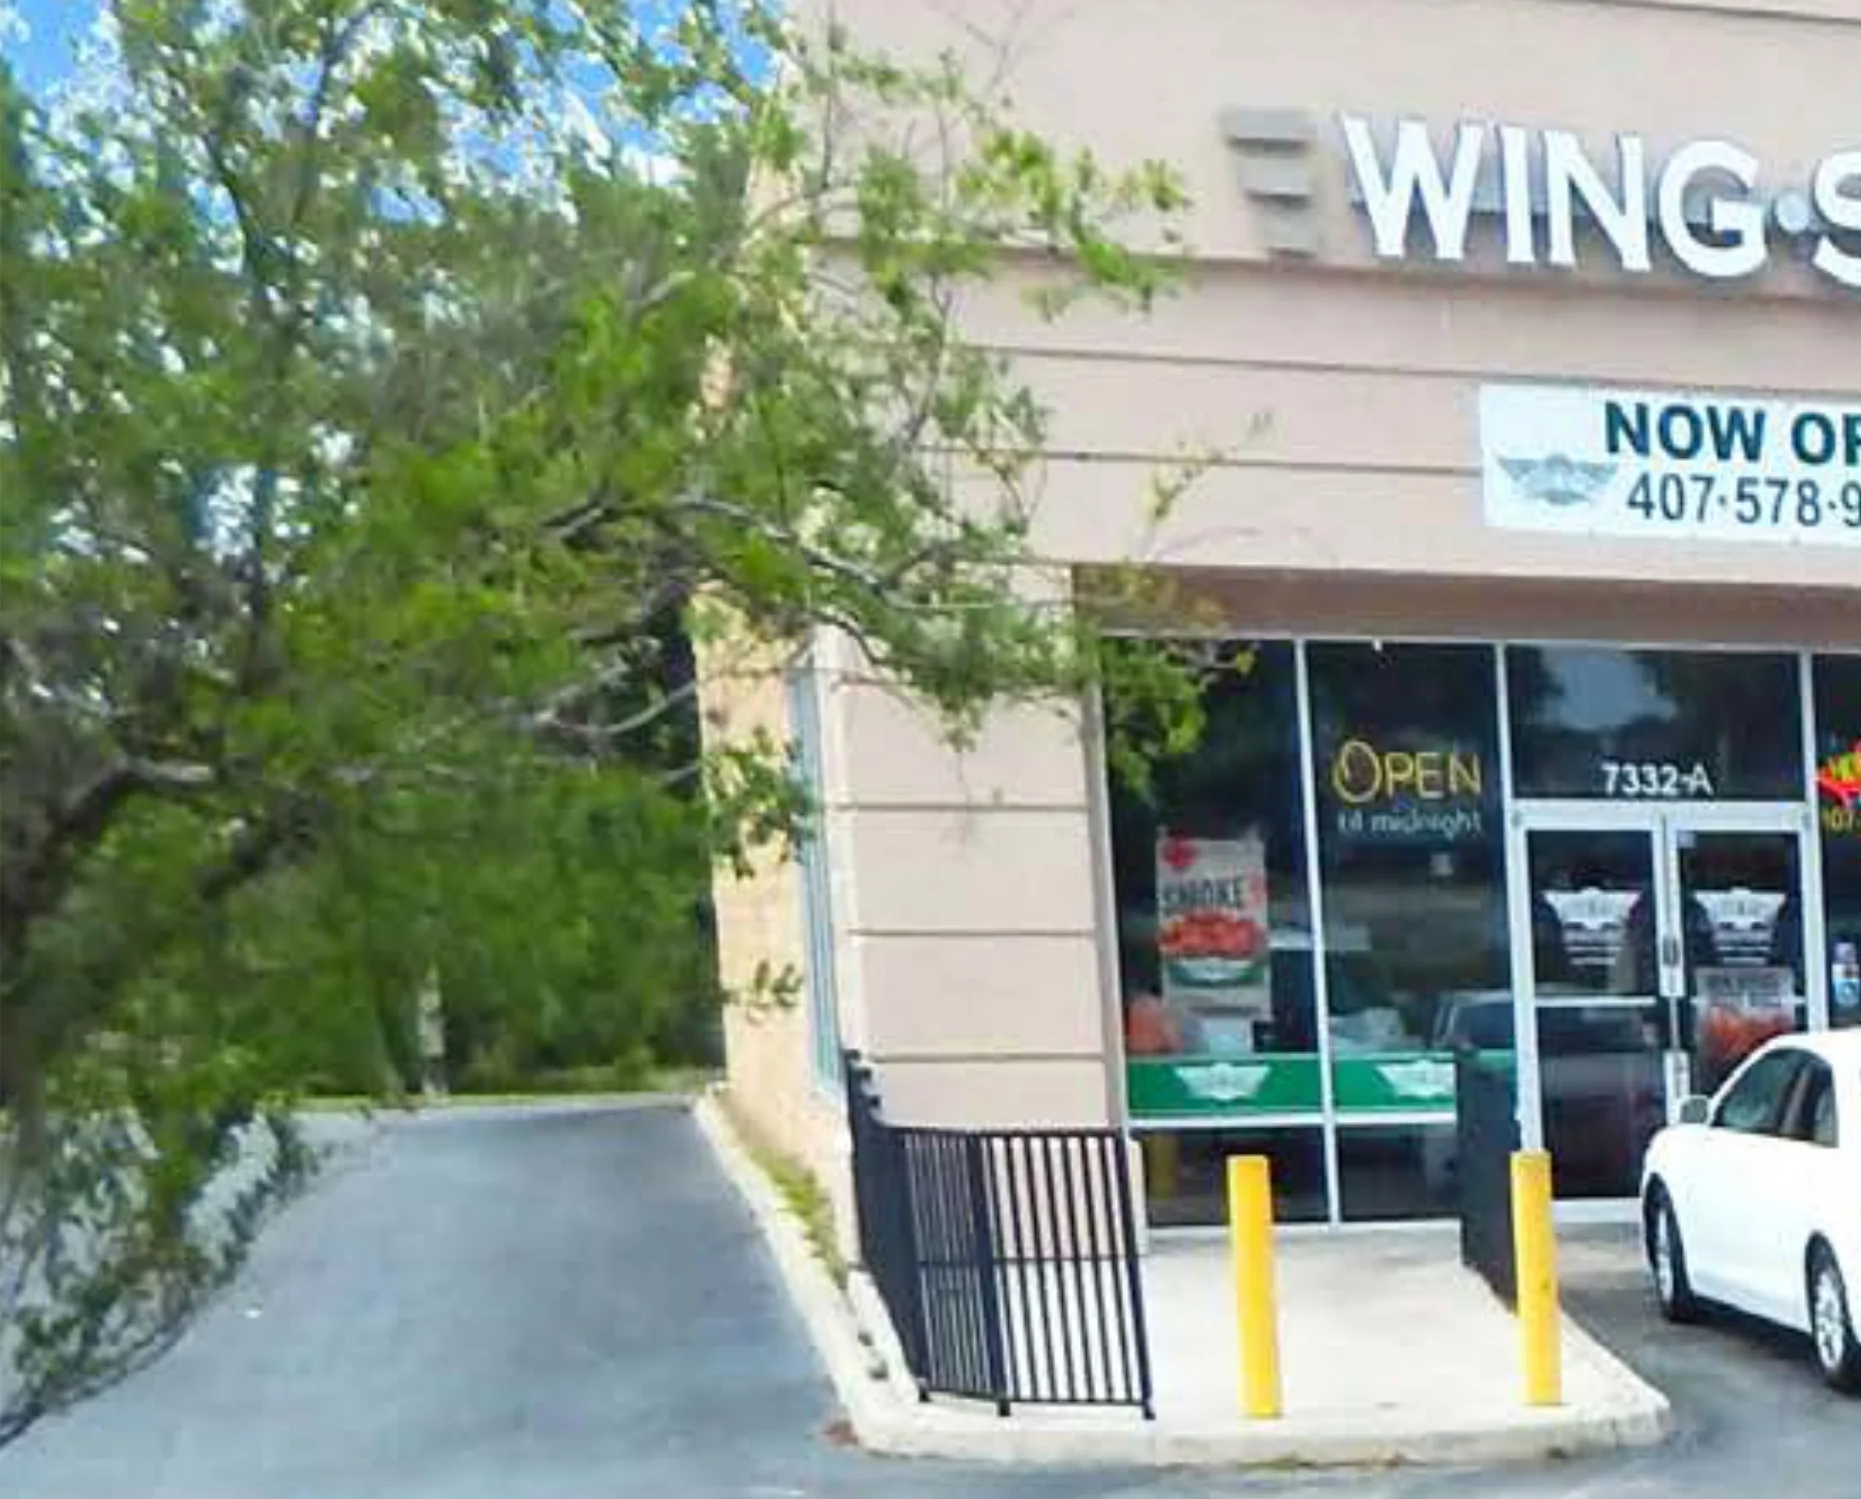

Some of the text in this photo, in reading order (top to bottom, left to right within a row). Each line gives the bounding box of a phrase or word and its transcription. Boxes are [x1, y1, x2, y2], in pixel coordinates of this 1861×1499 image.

[1604, 400, 1767, 462] NOW
[1330, 737, 1483, 804] OPEN
[1600, 761, 1715, 797] 7332-A
